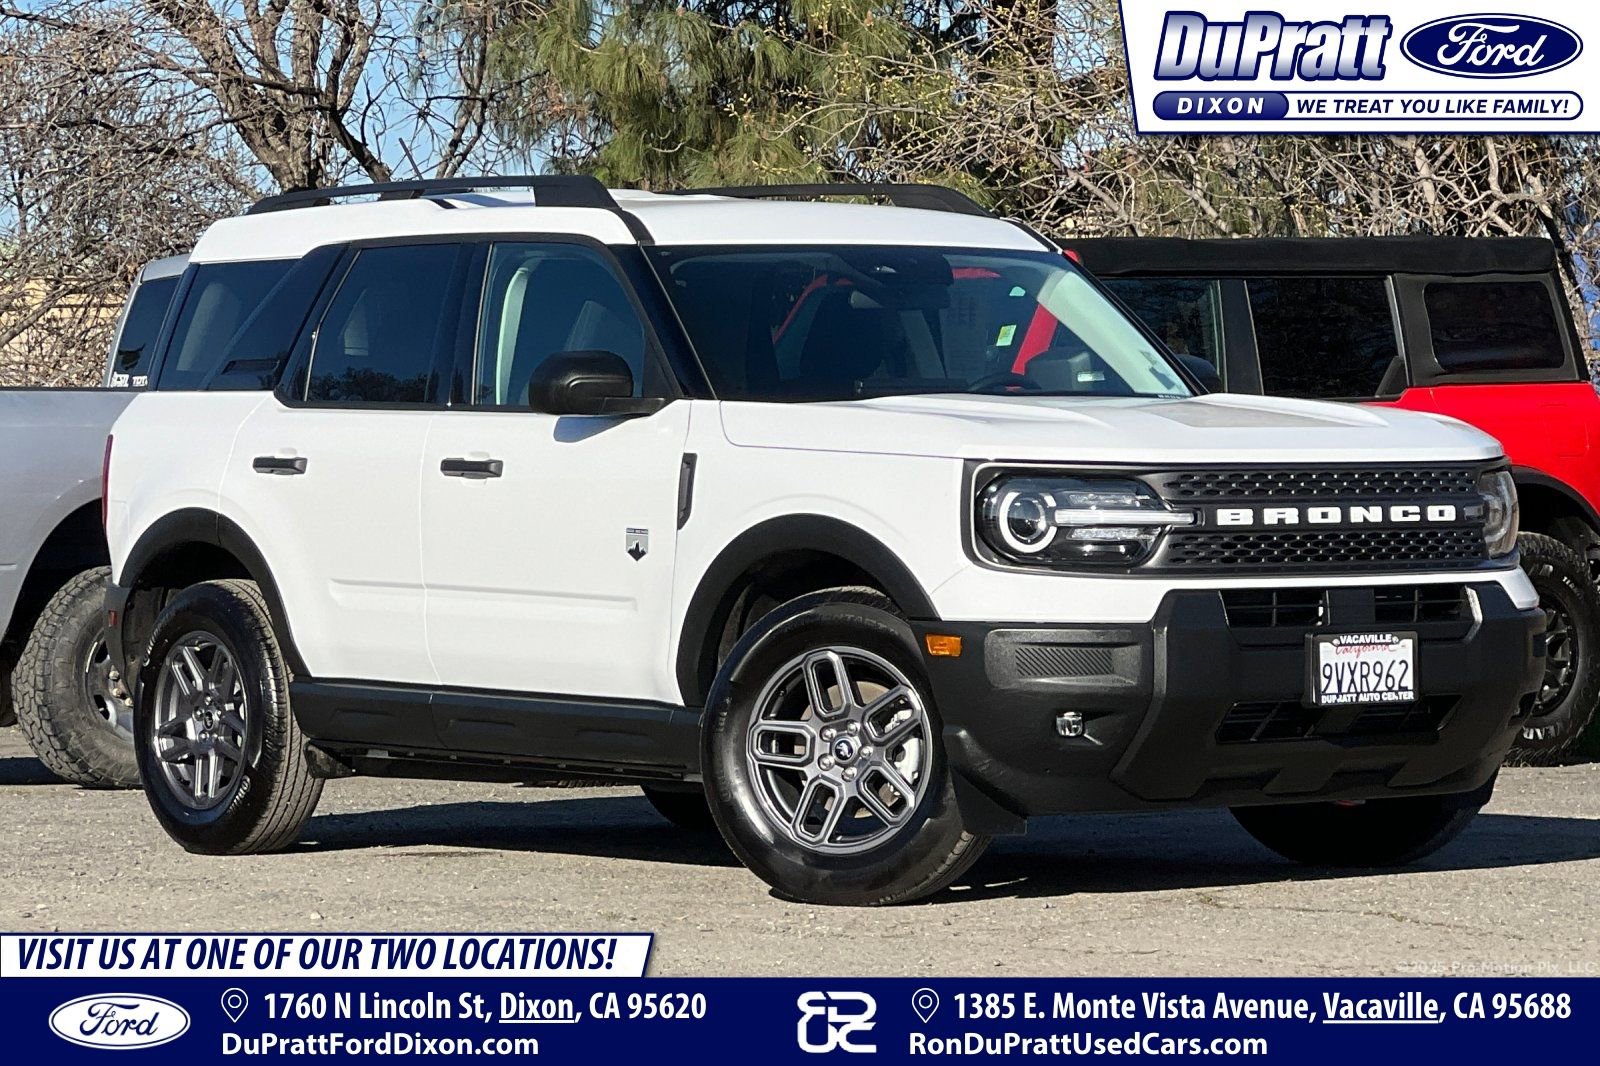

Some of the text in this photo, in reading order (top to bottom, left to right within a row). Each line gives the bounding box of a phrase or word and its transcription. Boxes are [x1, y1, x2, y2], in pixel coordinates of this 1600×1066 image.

[1216, 505, 1456, 526] BRONCO
[1340, 634, 1392, 645] VACAVILLE
[1321, 660, 1409, 694] 9VXR962
[1359, 692, 1380, 702] AUTO
